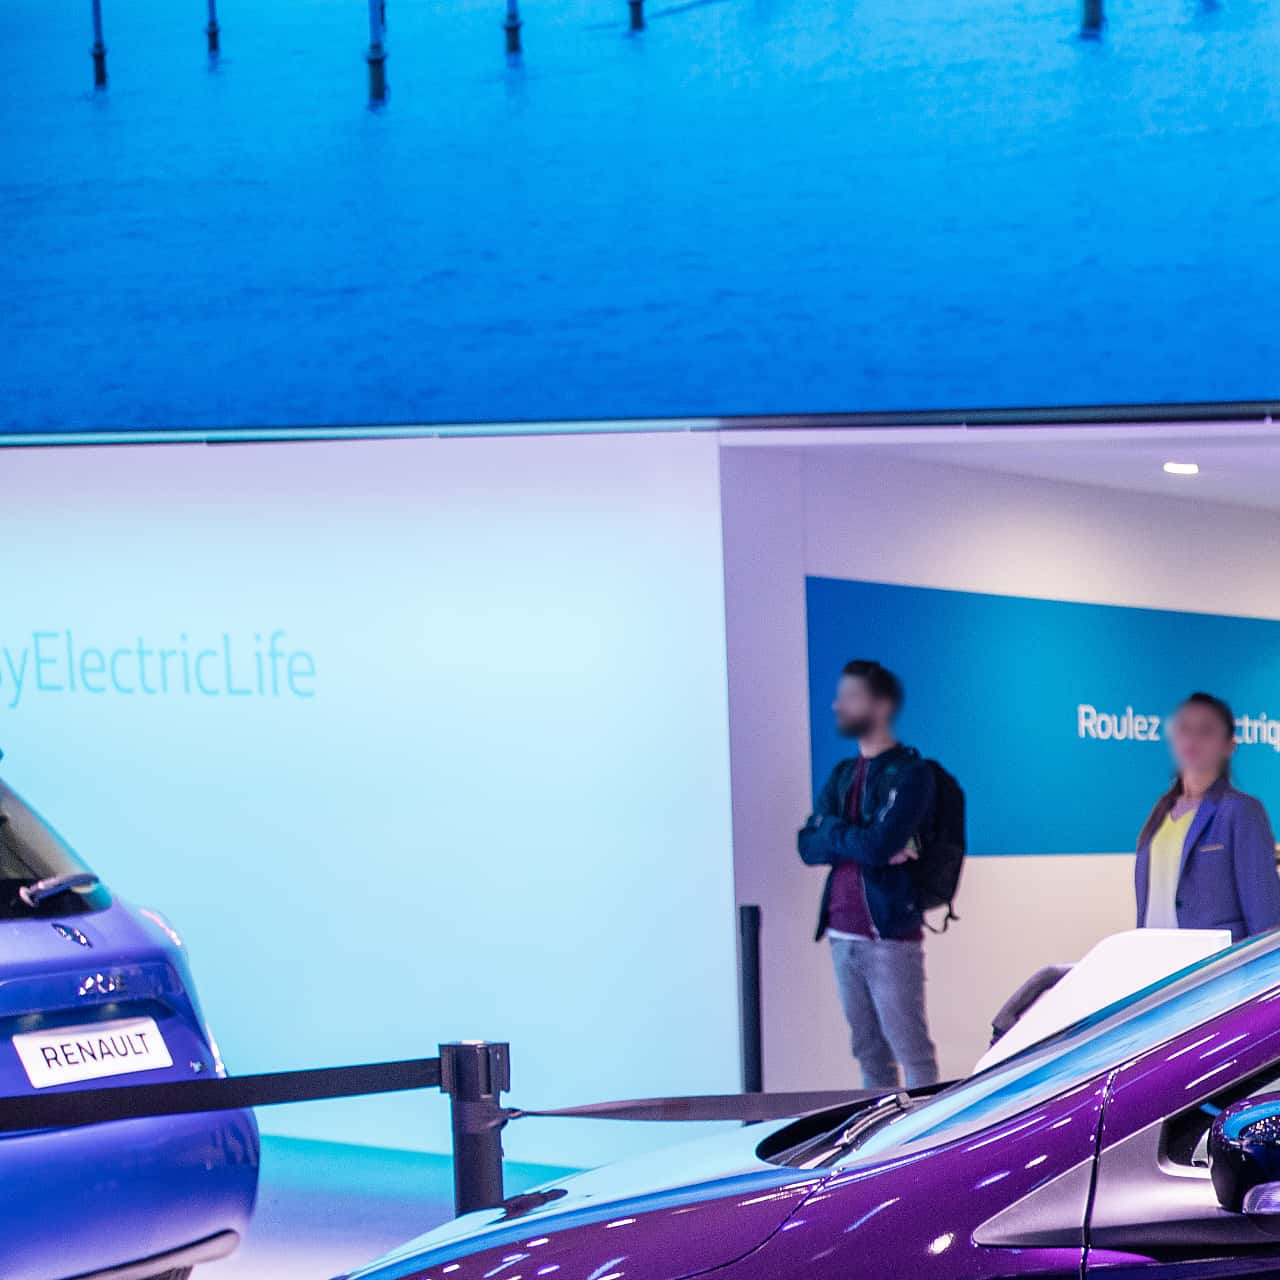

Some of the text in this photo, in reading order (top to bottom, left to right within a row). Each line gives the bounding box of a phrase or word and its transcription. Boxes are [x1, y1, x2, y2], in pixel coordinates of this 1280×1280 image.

[0, 629, 316, 708] yElectricLife
[1077, 703, 1161, 742] Roulez
[40, 1032, 151, 1069] RENAULT
